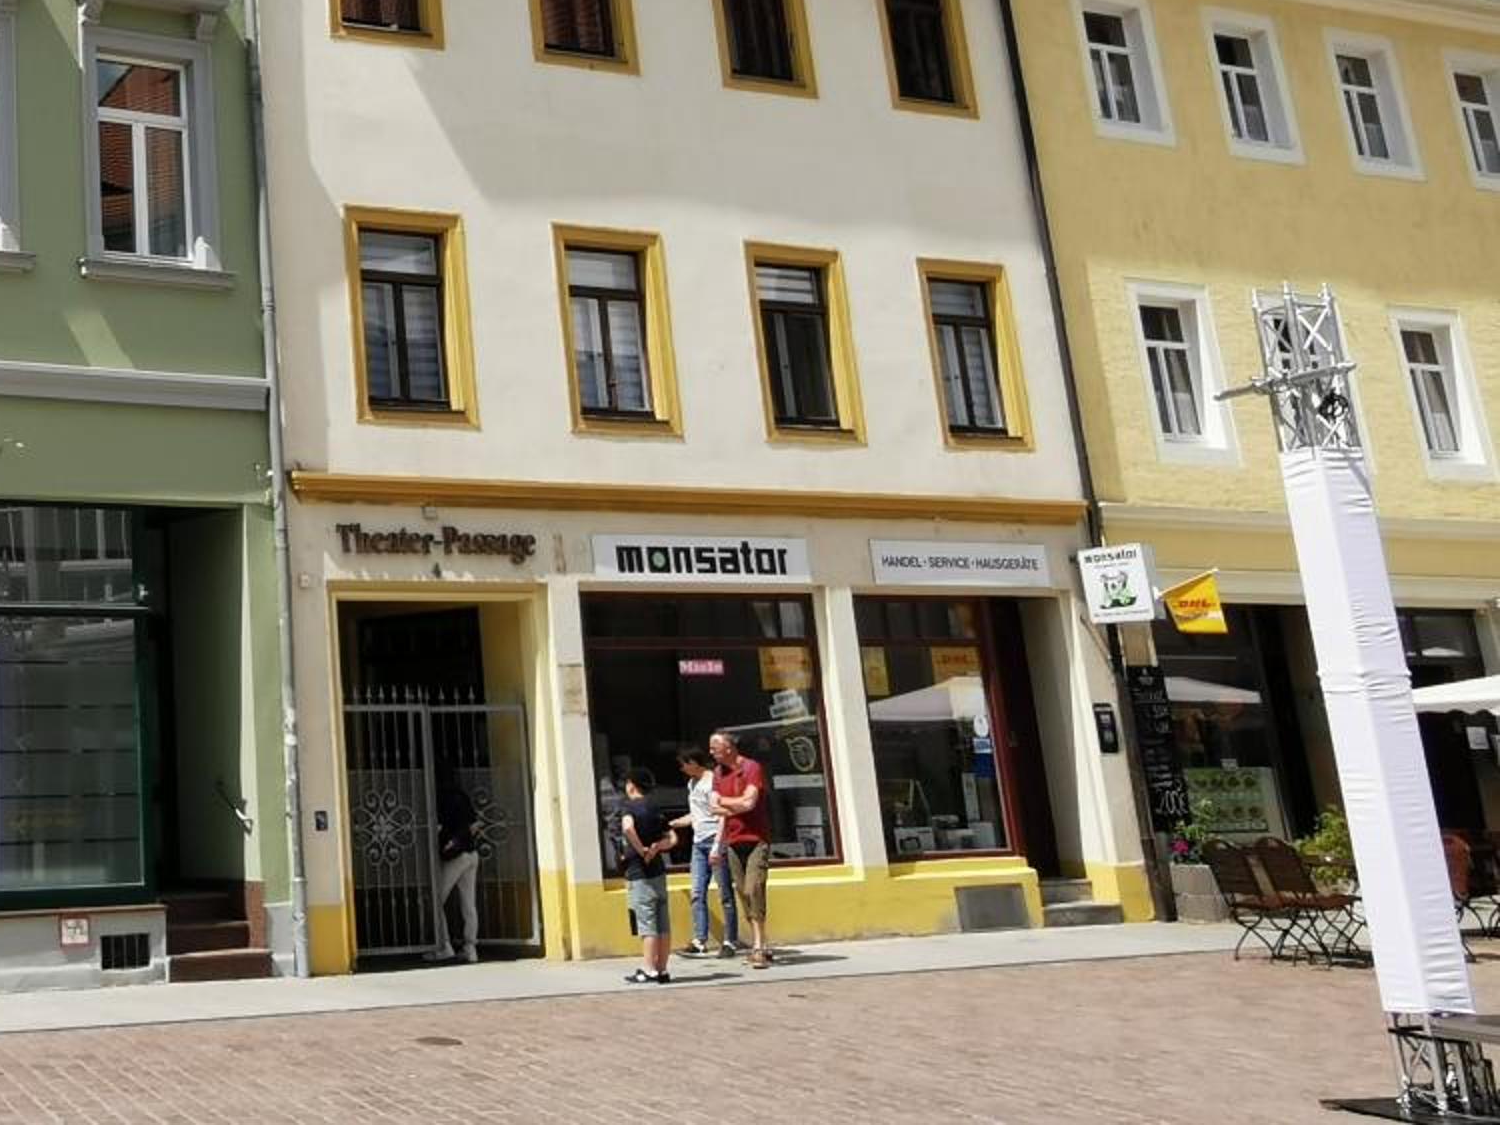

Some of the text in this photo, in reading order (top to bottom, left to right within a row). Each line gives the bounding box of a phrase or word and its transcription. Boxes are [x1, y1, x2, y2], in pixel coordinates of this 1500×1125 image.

[336, 523, 536, 565] Theater-Passage
[615, 541, 787, 575] monsator
[881, 554, 1039, 571] HANDEL SERVICE HAUSGERÄTE
